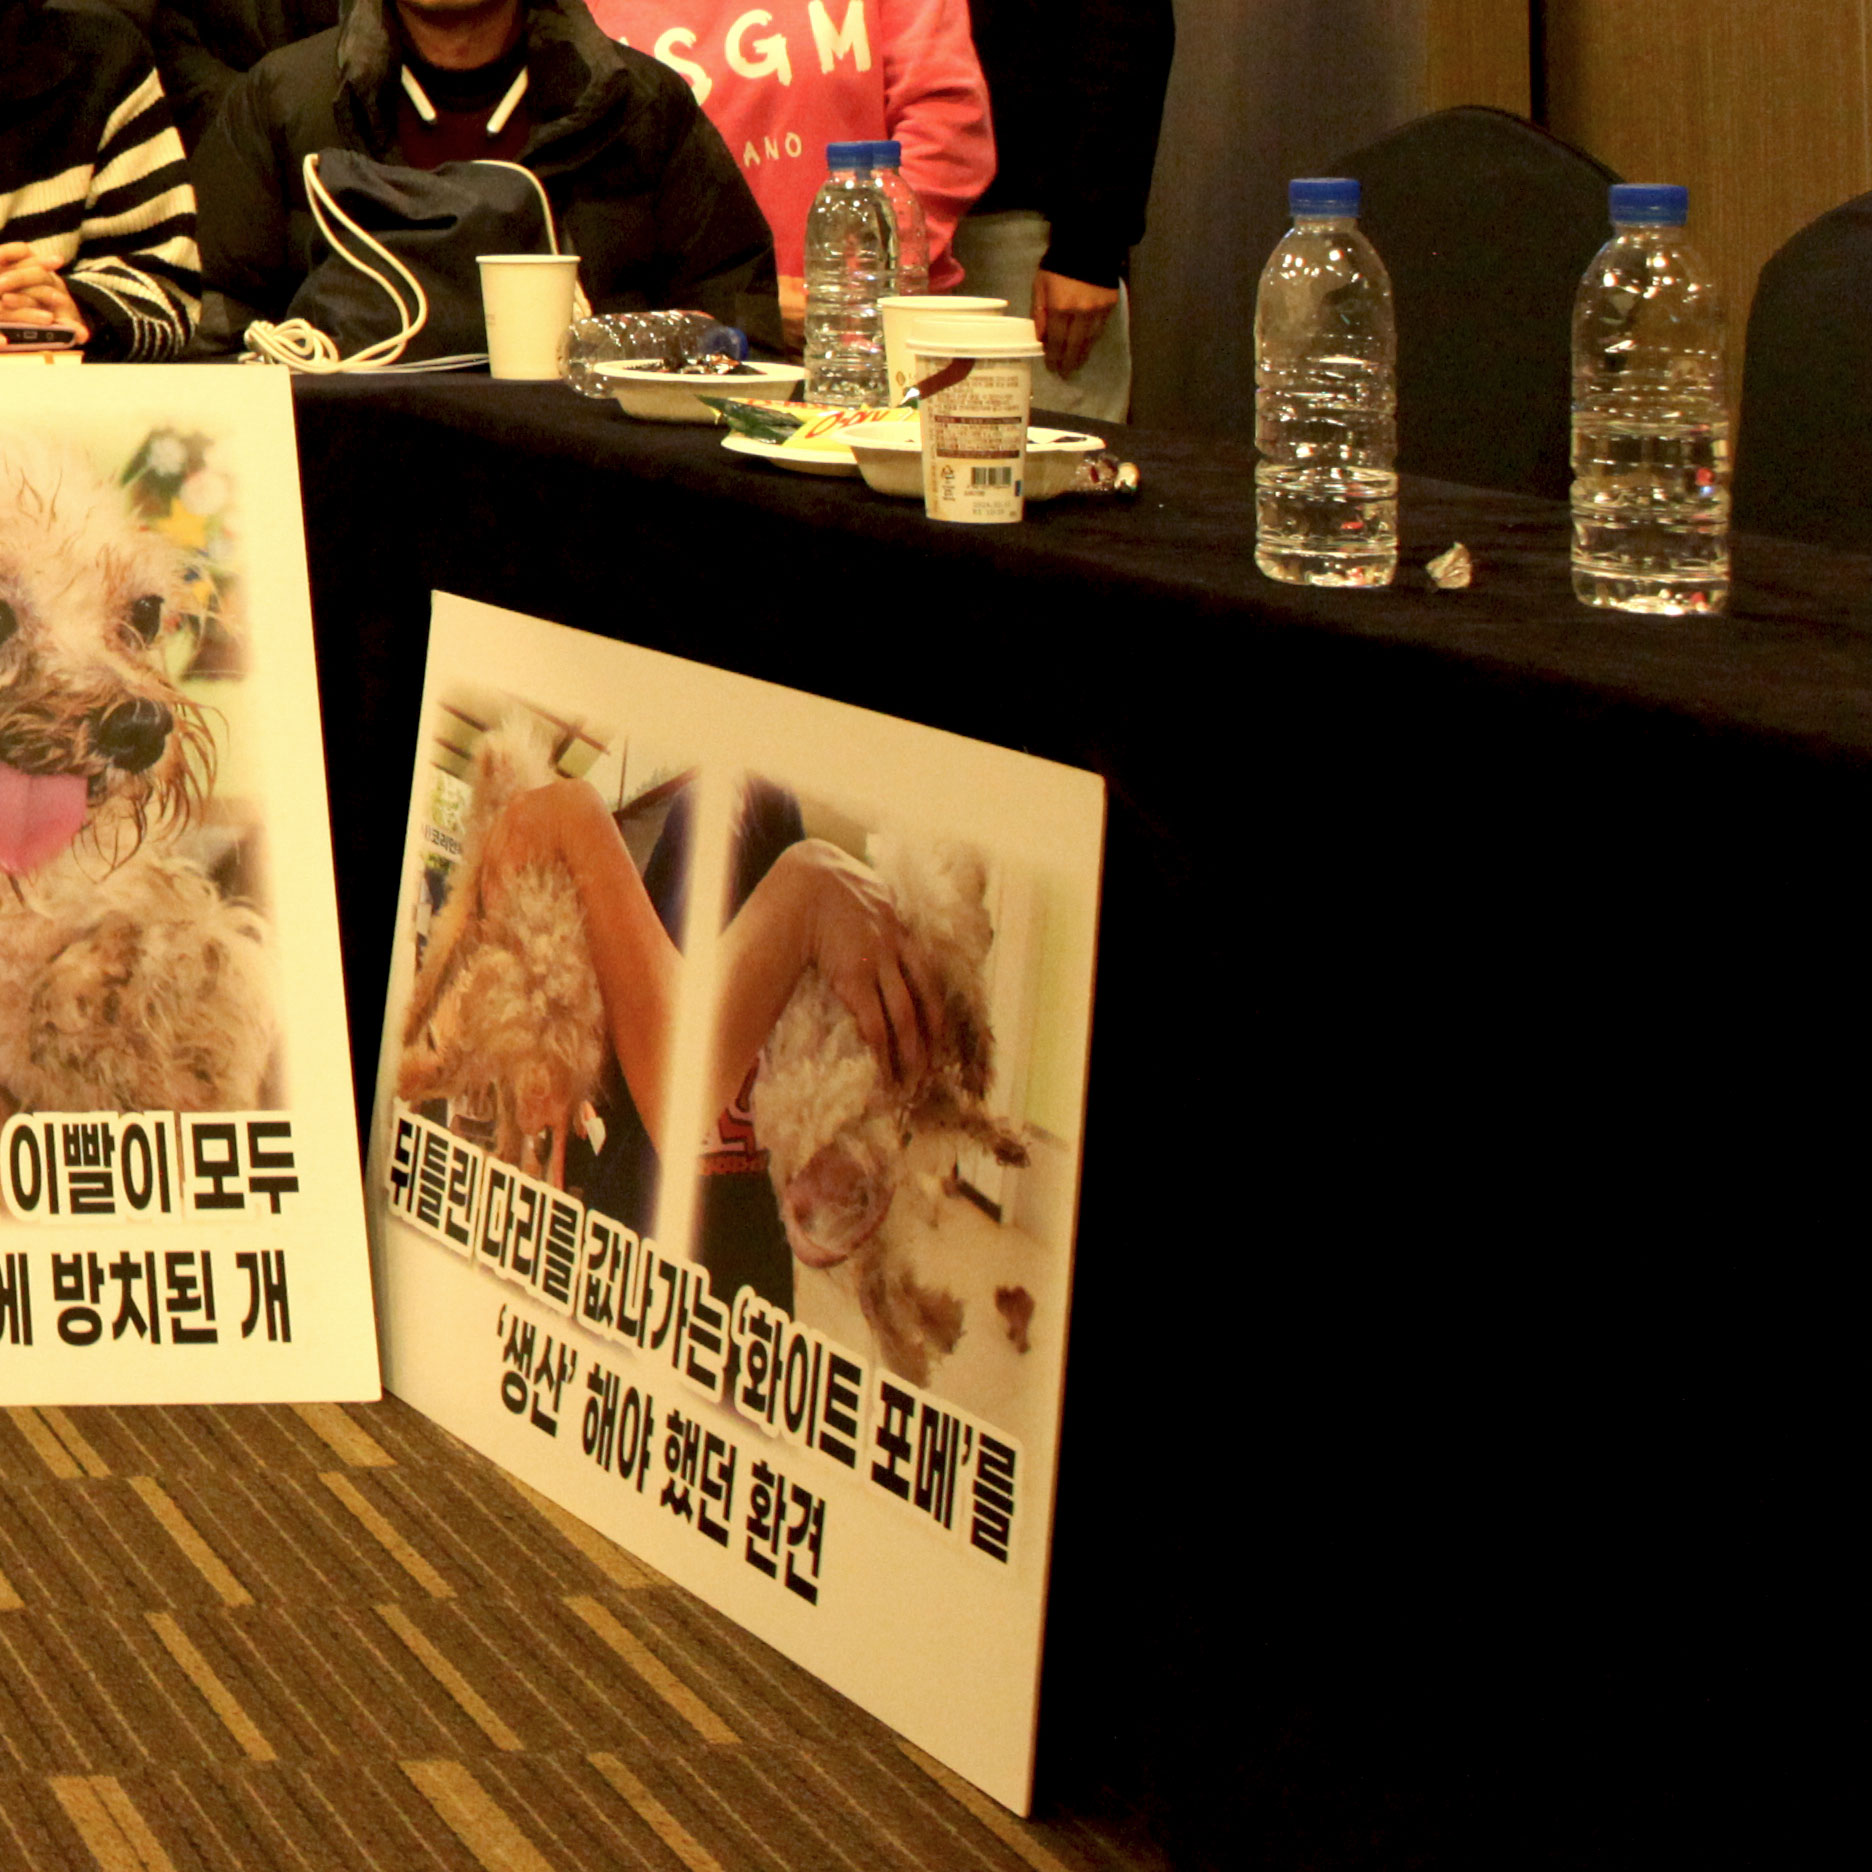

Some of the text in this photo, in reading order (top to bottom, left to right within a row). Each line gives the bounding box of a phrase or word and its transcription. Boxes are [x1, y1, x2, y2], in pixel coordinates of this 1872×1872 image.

[742, 132, 802, 168] ANO
[10, 1121, 172, 1215] 이빨이
[192, 1121, 300, 1215] 모두
[52, 1250, 218, 1346] 방치된
[236, 1249, 291, 1344] 개
[391, 1118, 478, 1246] 뒤틀린
[481, 1168, 579, 1307] 다리를
[583, 1221, 723, 1392] 값나가는
[582, 1362, 655, 1492] 해야
[660, 1408, 738, 1549] 했던
[744, 1461, 826, 1606] 환견
